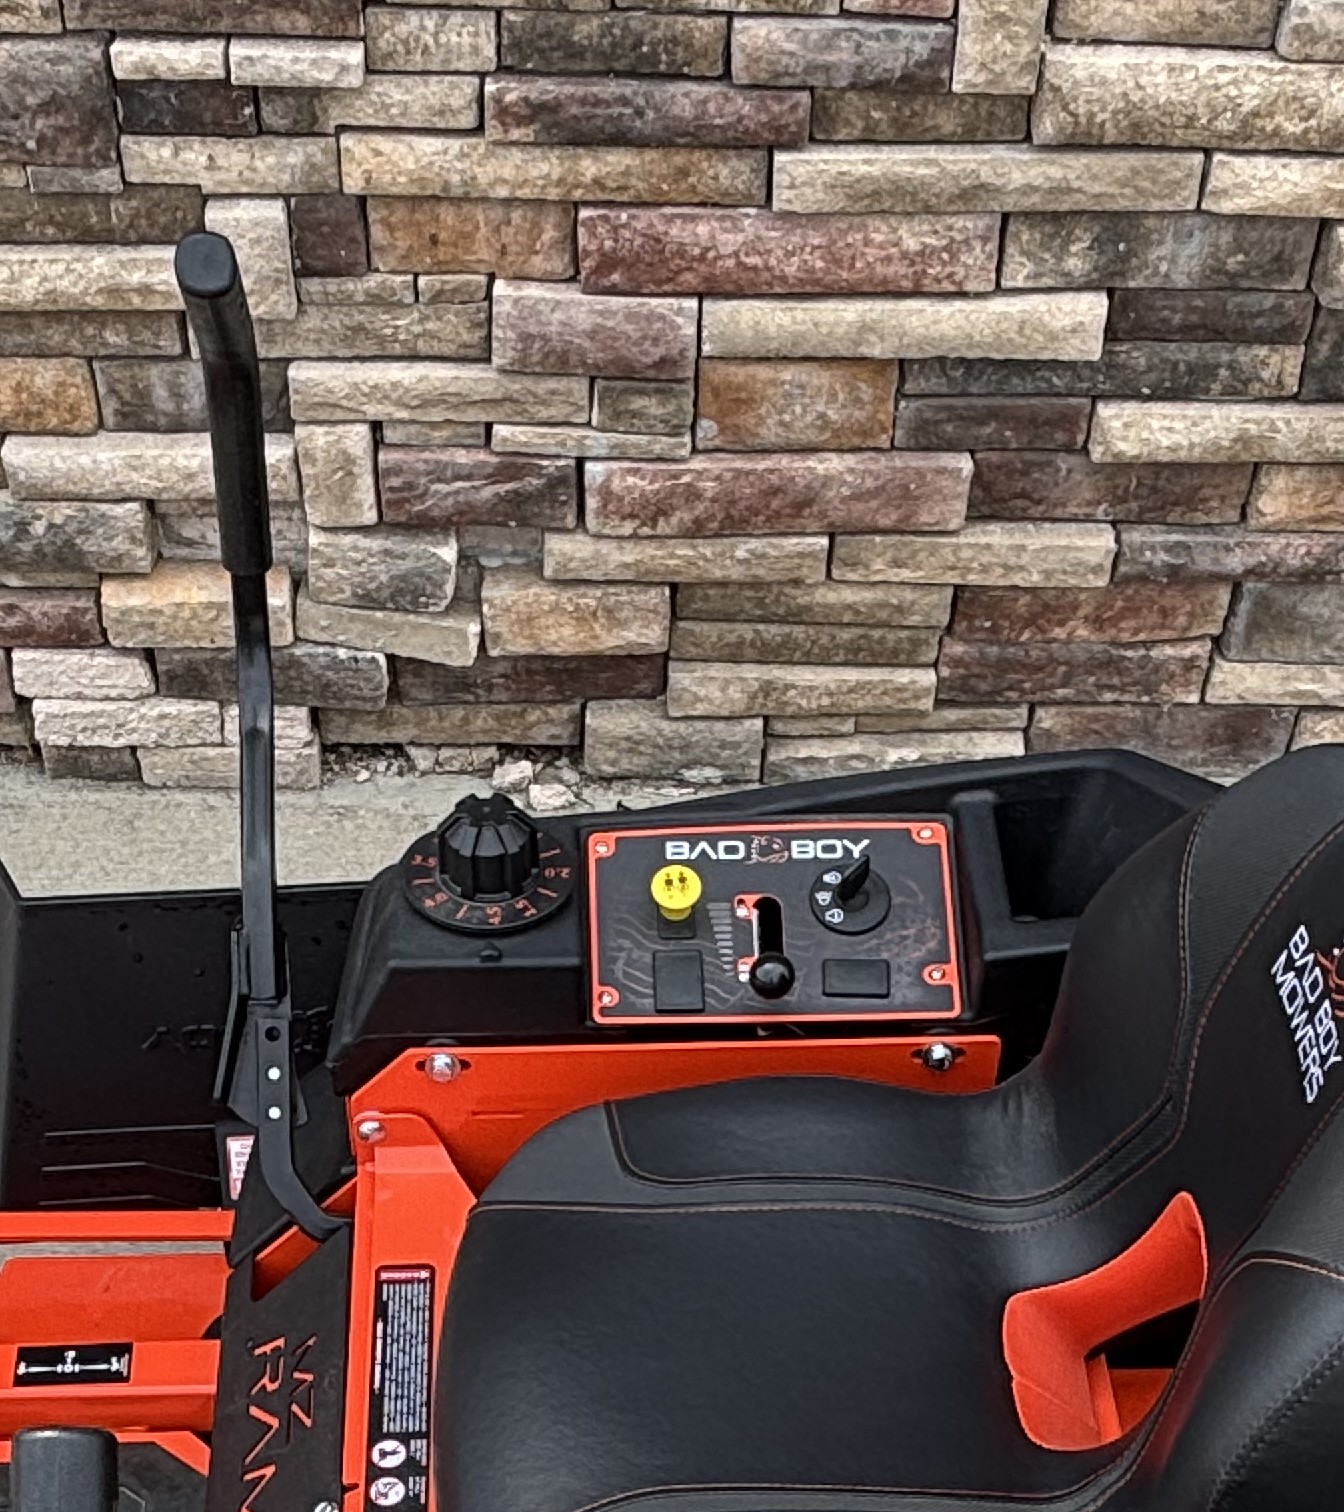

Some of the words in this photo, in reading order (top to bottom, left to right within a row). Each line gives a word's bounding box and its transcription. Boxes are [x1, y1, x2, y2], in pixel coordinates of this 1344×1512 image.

[665, 840, 746, 860] BAD
[790, 838, 871, 860] BOY
[1270, 948, 1325, 1104] MOWERS
[1288, 924, 1324, 1004] BAD
[1314, 998, 1343, 1072] BOY
